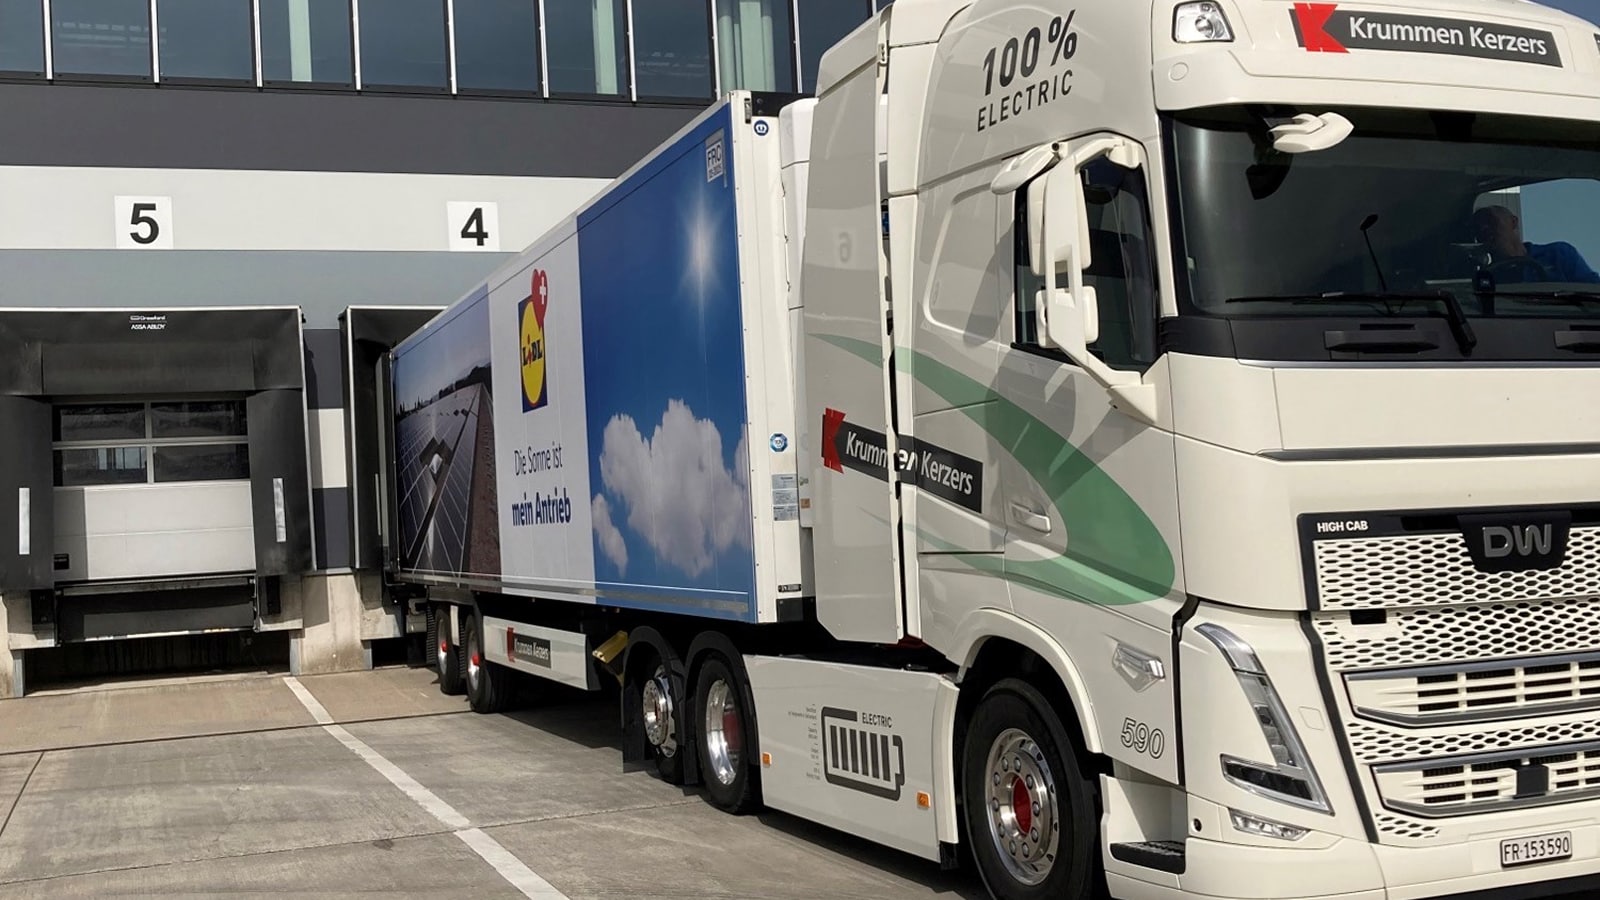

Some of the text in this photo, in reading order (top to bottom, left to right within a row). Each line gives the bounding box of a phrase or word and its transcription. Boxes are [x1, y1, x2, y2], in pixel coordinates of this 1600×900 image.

[1350, 16, 1464, 46] Krummen
[1469, 26, 1548, 56] Kerzers
[977, 69, 1073, 132] ELECTRIC
[129, 202, 160, 244] 5
[460, 207, 489, 247] 4
[514, 440, 563, 476] Die Sonne ist
[921, 450, 973, 495] Kerzers
[512, 486, 571, 526] mein Antrieb
[1317, 521, 1369, 533] HIGH CAB
[1482, 524, 1552, 558] DW
[862, 712, 893, 728] ELECTRIC
[1121, 717, 1165, 760] 590
